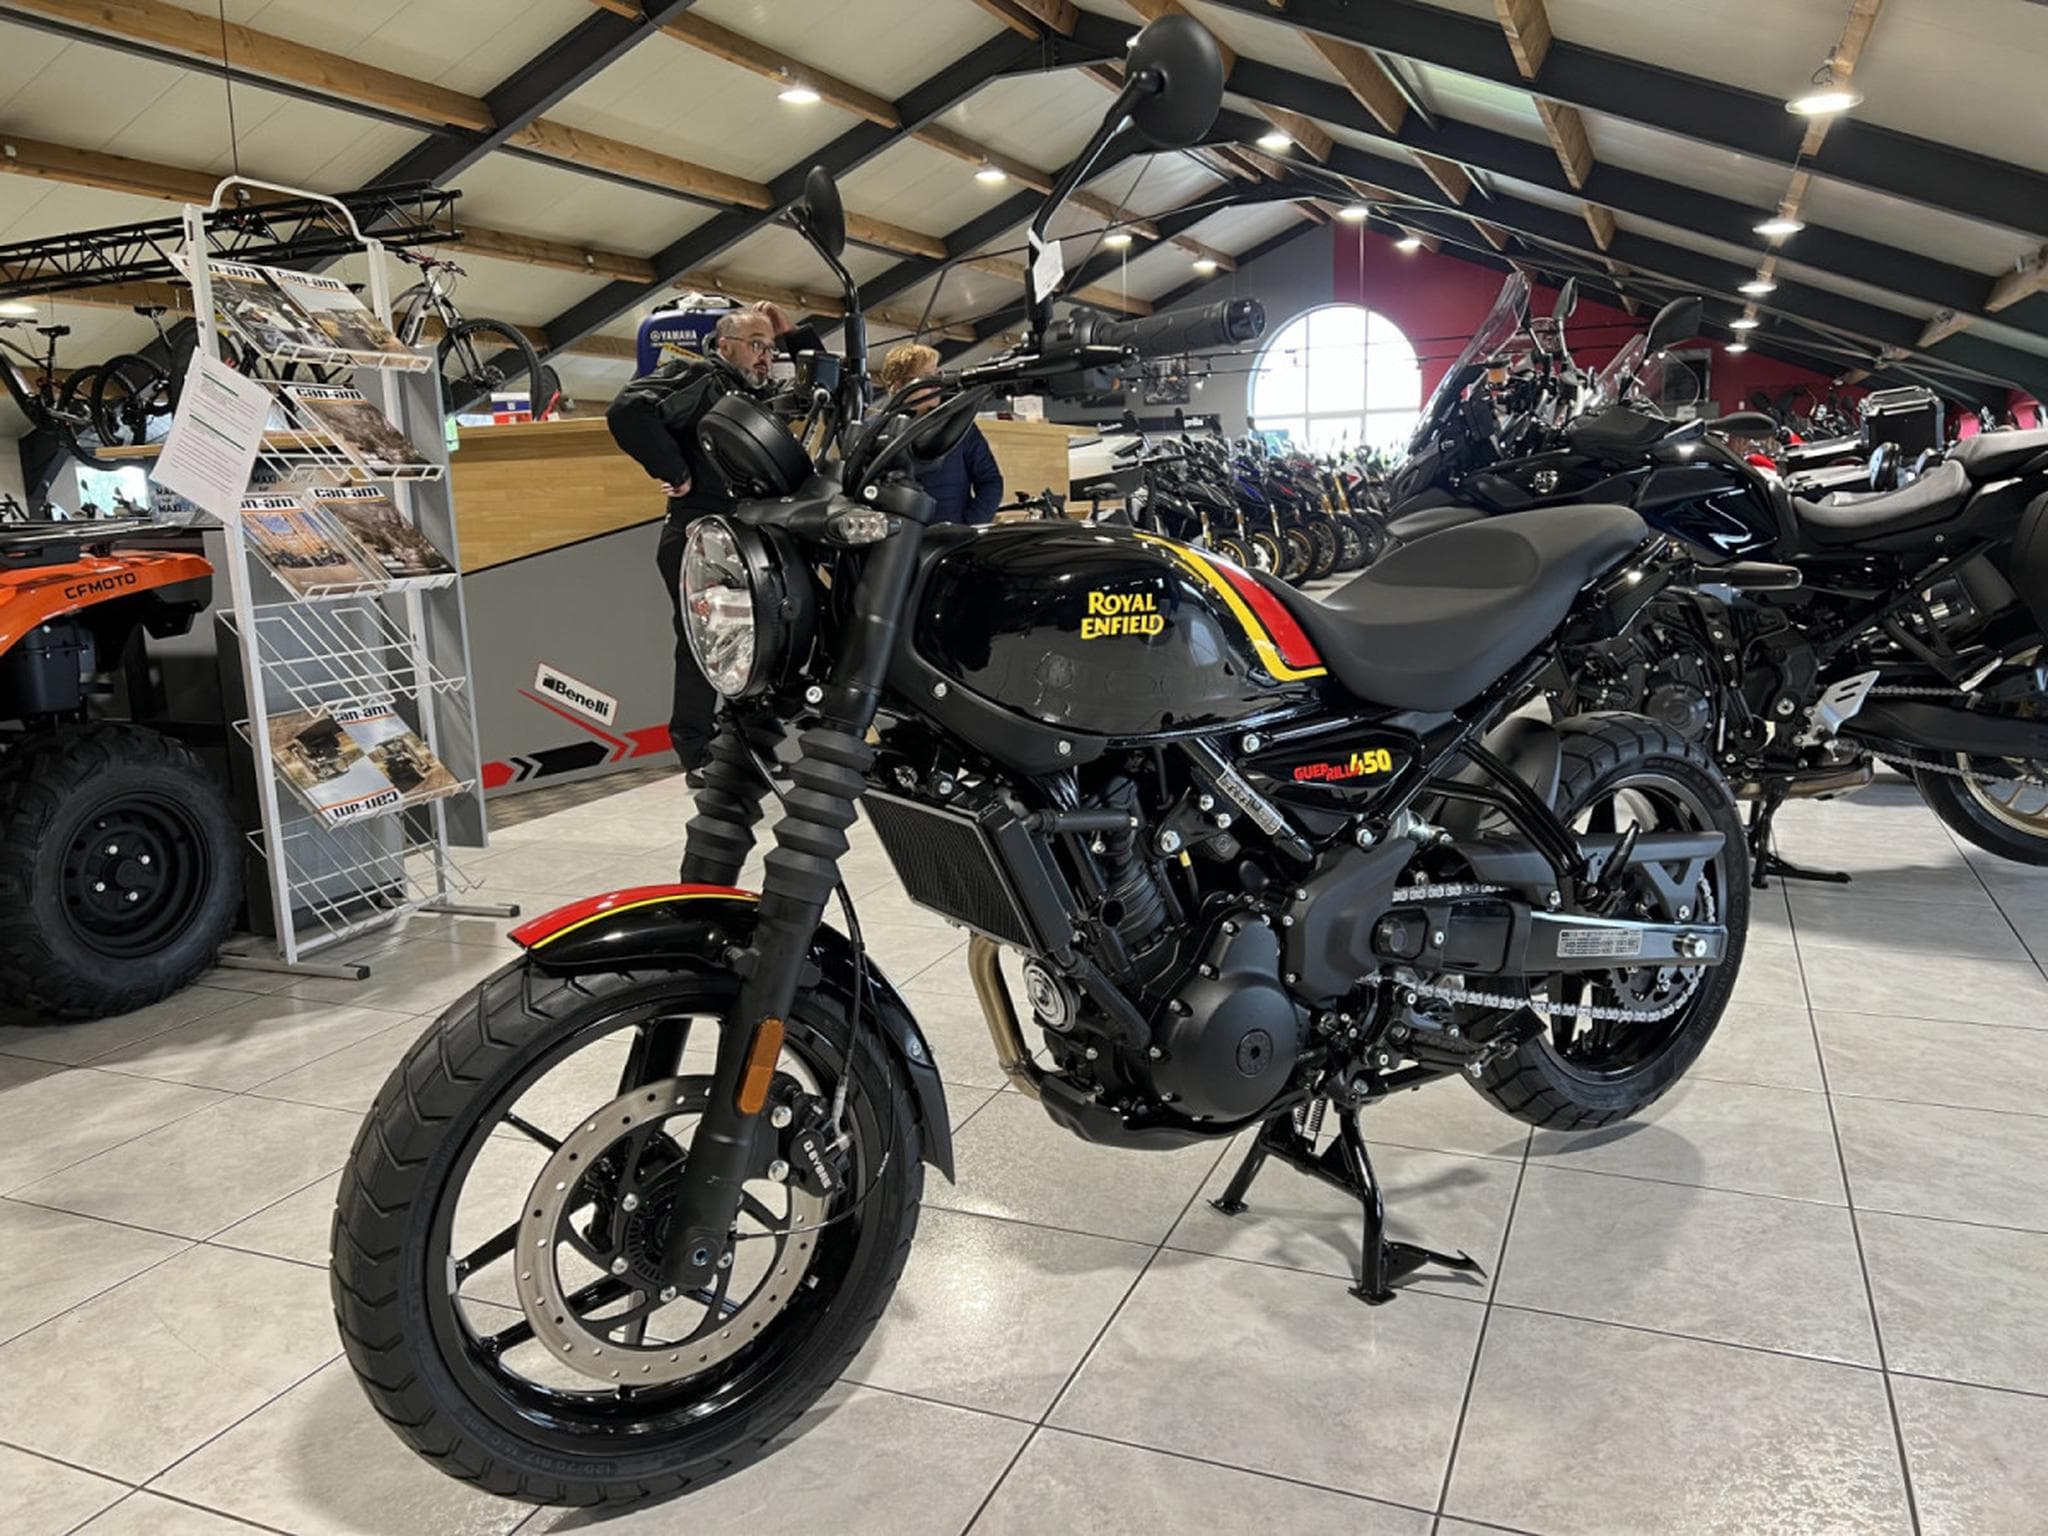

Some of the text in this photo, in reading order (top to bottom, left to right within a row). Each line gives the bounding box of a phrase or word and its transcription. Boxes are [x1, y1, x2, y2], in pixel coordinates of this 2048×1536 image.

[660, 330, 698, 340] YAMAHA
[296, 388, 361, 400] can-am
[241, 497, 295, 510] n-am
[314, 487, 380, 498] can-am
[64, 572, 137, 600] CFMOTO
[1088, 591, 1157, 616] ROYAL
[1081, 614, 1165, 640] ENFIELD
[555, 680, 609, 717] Benelli
[1350, 748, 1392, 776] 450
[333, 791, 398, 818] can-am
